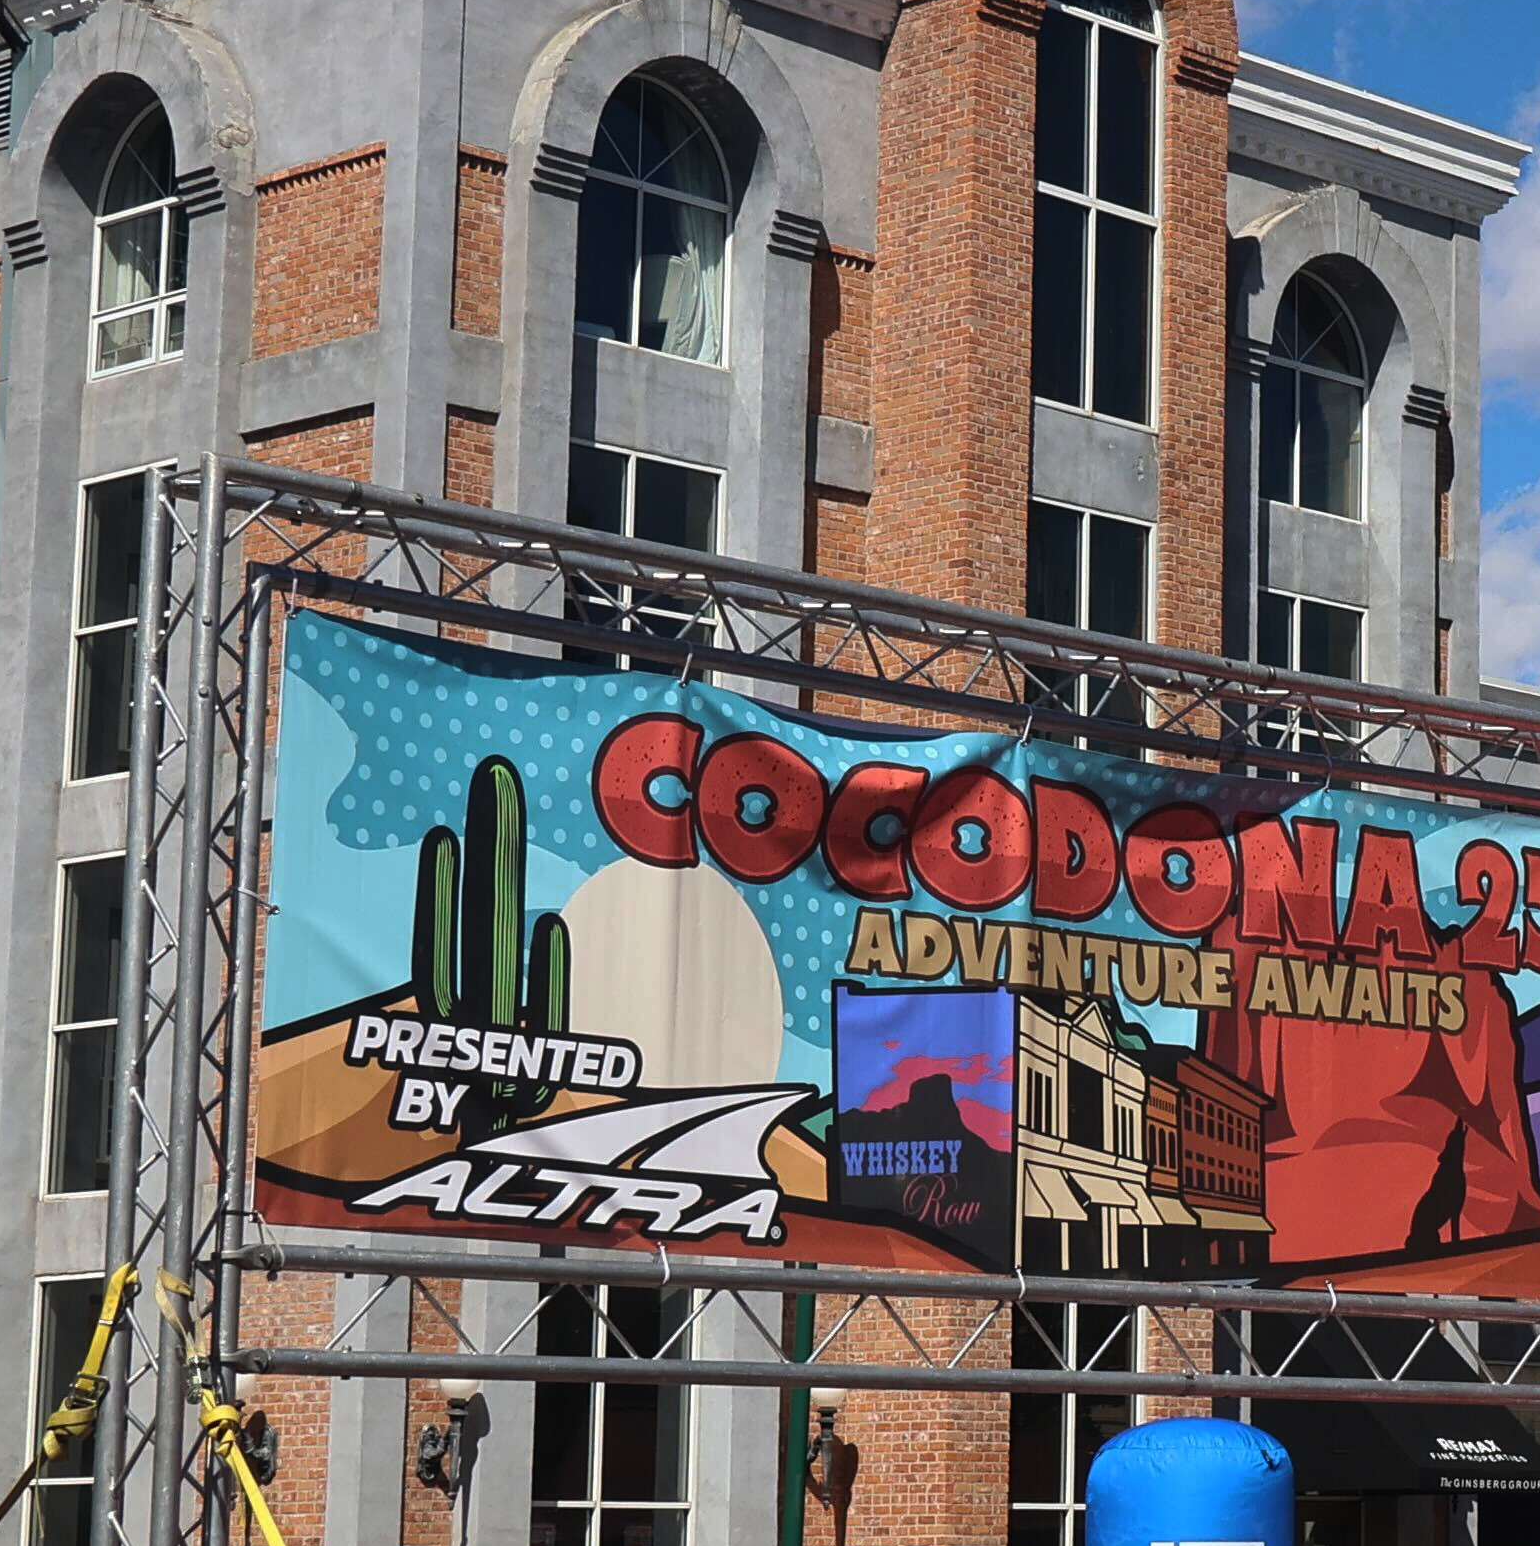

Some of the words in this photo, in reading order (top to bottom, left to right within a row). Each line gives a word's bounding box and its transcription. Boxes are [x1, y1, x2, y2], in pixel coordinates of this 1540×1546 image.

[594, 712, 1435, 959] COCODONA
[845, 907, 1236, 1009] ADVENTURE
[1246, 951, 1465, 1035] AWAITS
[350, 1015, 637, 1089] PRESENTED
[394, 1078, 469, 1127] BY
[841, 1139, 962, 1176] WHISKEY
[903, 1173, 981, 1228] Row
